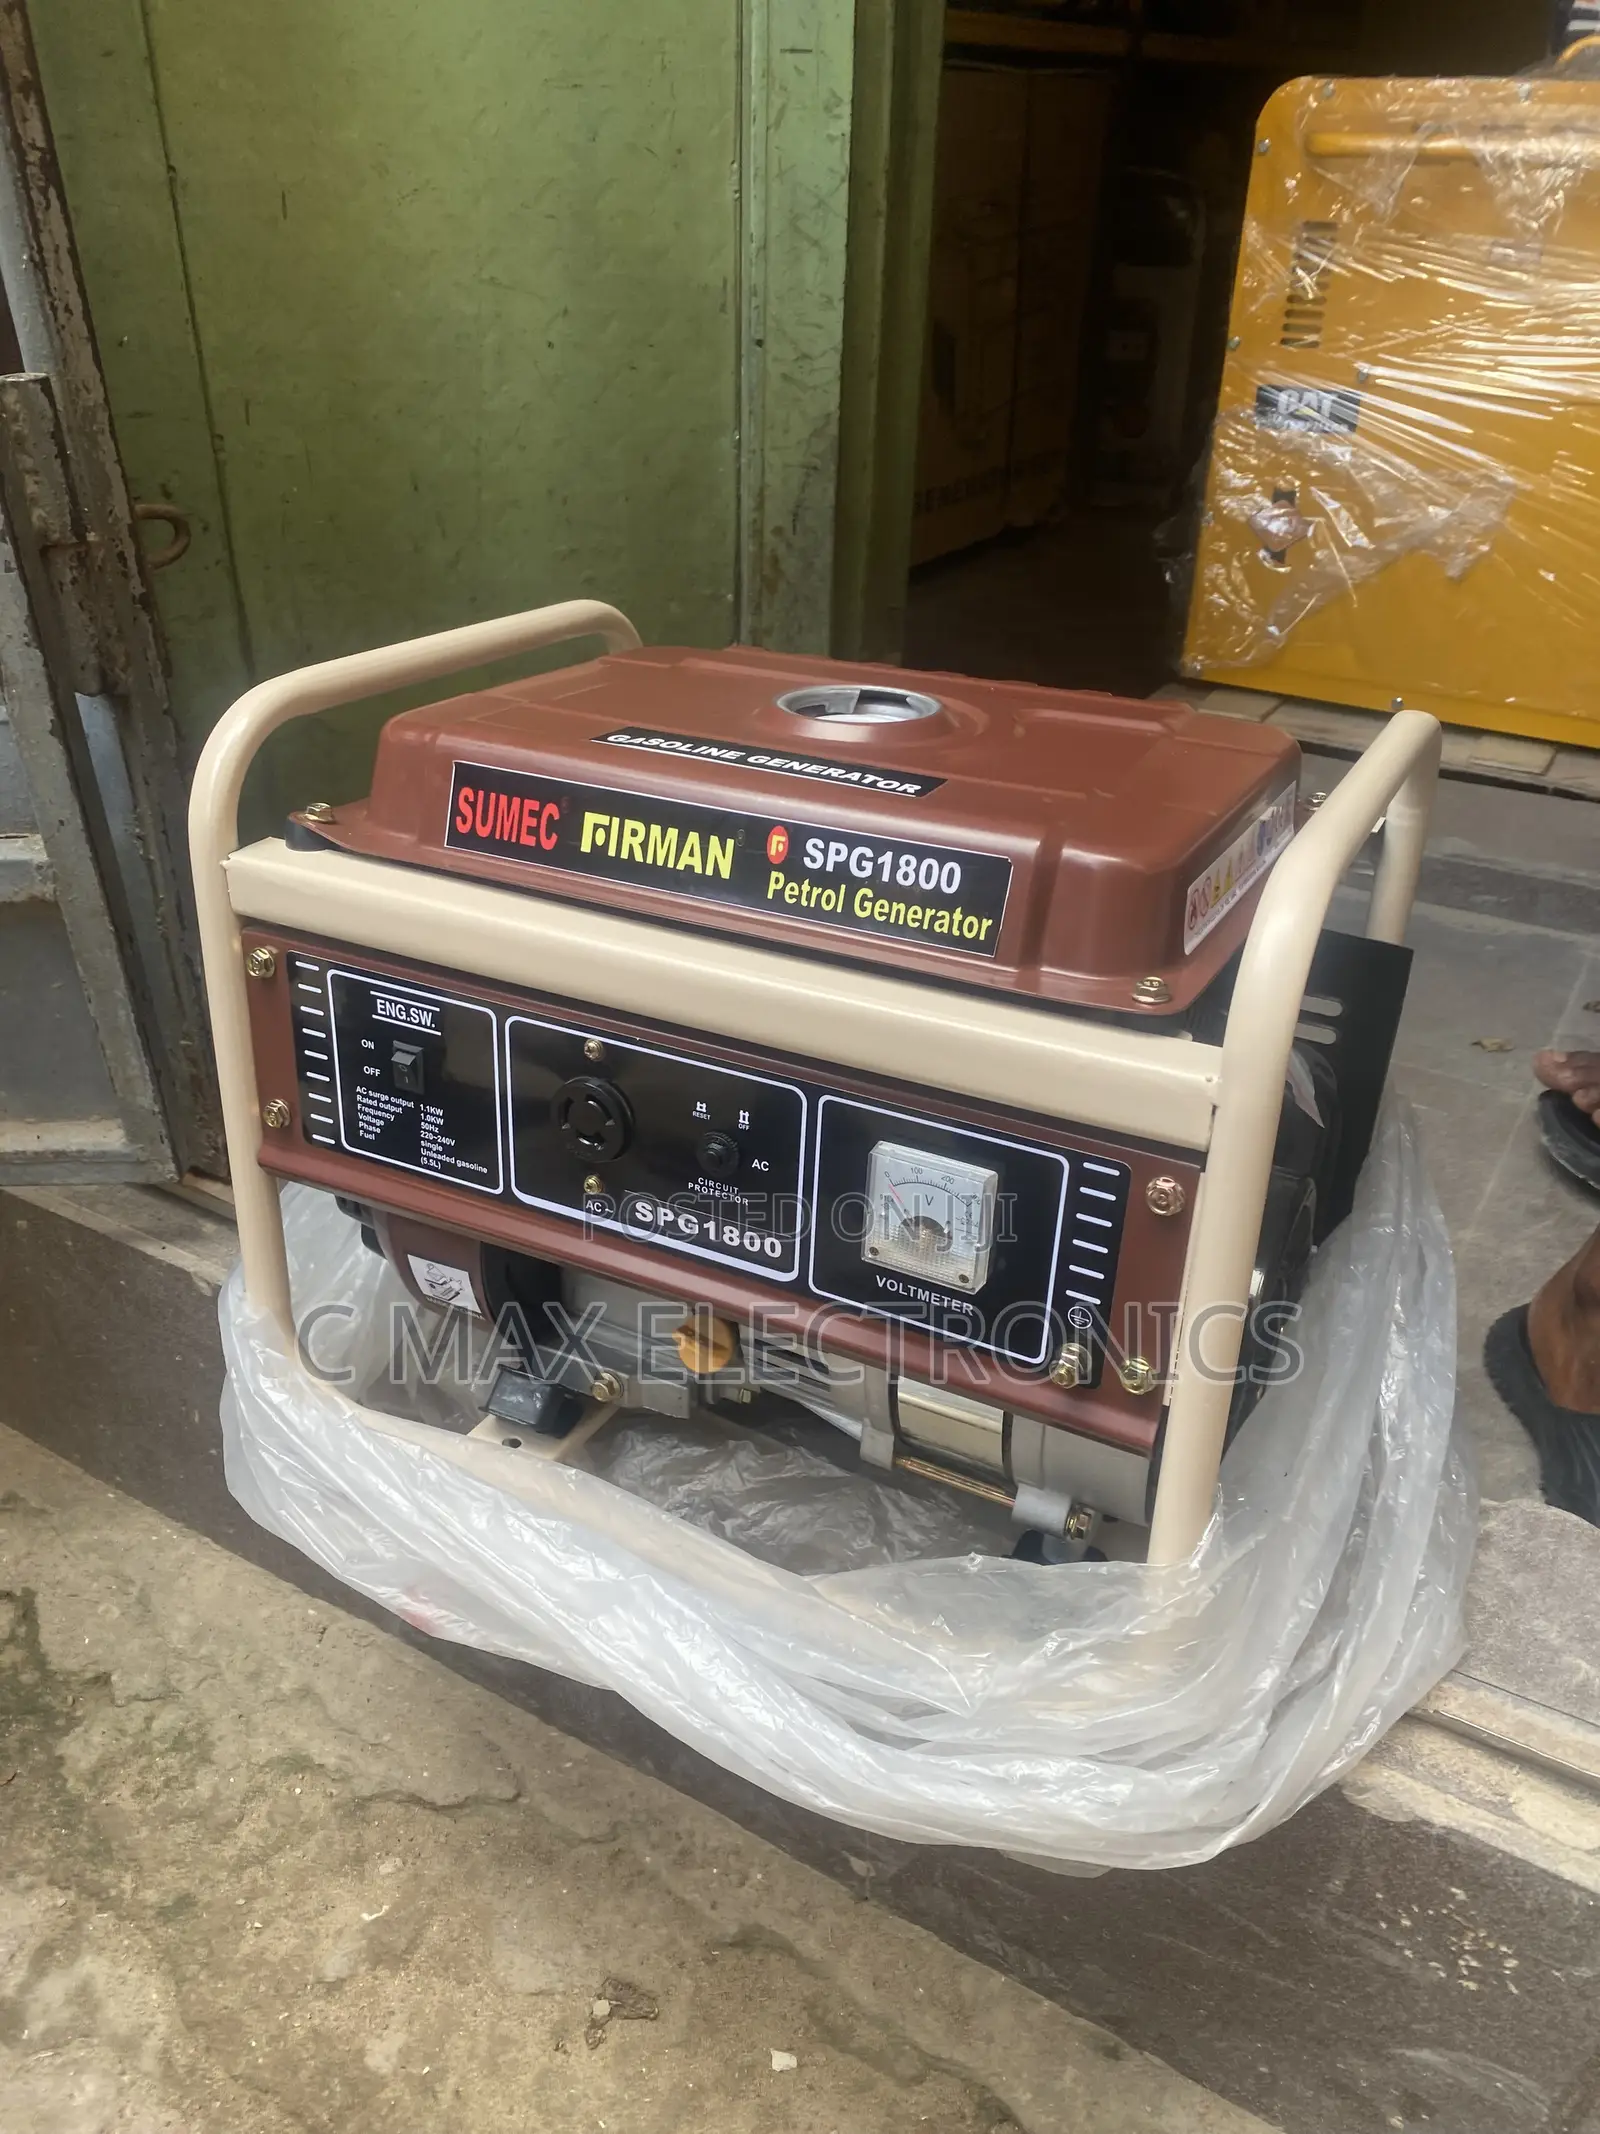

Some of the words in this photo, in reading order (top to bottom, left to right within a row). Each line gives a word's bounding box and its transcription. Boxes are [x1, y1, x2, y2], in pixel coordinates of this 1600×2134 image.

[606, 733, 745, 760] GASOLINE
[747, 755, 922, 793] GENERATOR
[456, 786, 560, 850] SUMEC
[580, 811, 735, 880] FIRMAN
[803, 837, 962, 894] SPG1800
[767, 871, 846, 914] Petrol
[853, 887, 993, 941] Generator
[376, 998, 436, 1028] ENG.SW.
[361, 1038, 375, 1050] ON
[363, 1065, 381, 1077] OFF
[356, 1085, 367, 1095] AC
[368, 1090, 390, 1101] surge
[390, 1096, 415, 1108] output
[420, 1103, 444, 1117] 1.1KW
[356, 1094, 378, 1107] Rated
[379, 1102, 403, 1114] output
[420, 1112, 444, 1126] 1.0KW
[692, 1110, 711, 1120] RESET
[357, 1103, 395, 1122] Frequency
[420, 1121, 439, 1133] 50Hz
[357, 1112, 385, 1126] Voltage
[738, 1123, 750, 1131] OFF
[358, 1121, 381, 1134] Phase
[420, 1140, 443, 1152] single
[359, 1129, 376, 1141] Fuel
[420, 1147, 455, 1164] Unleaded
[456, 1159, 488, 1174] gasoline
[420, 1156, 441, 1170] (5.5L)
[751, 1158, 770, 1172] AC
[910, 1166, 923, 1175] 100
[941, 1174, 955, 1185] 200
[687, 1182, 749, 1206] PROTECTOR
[697, 1177, 739, 1194] CIRCUIT
[925, 1194, 934, 1206] V
[634, 1201, 782, 1258] SPG1800
[875, 1274, 975, 1316] VOLTMETER
